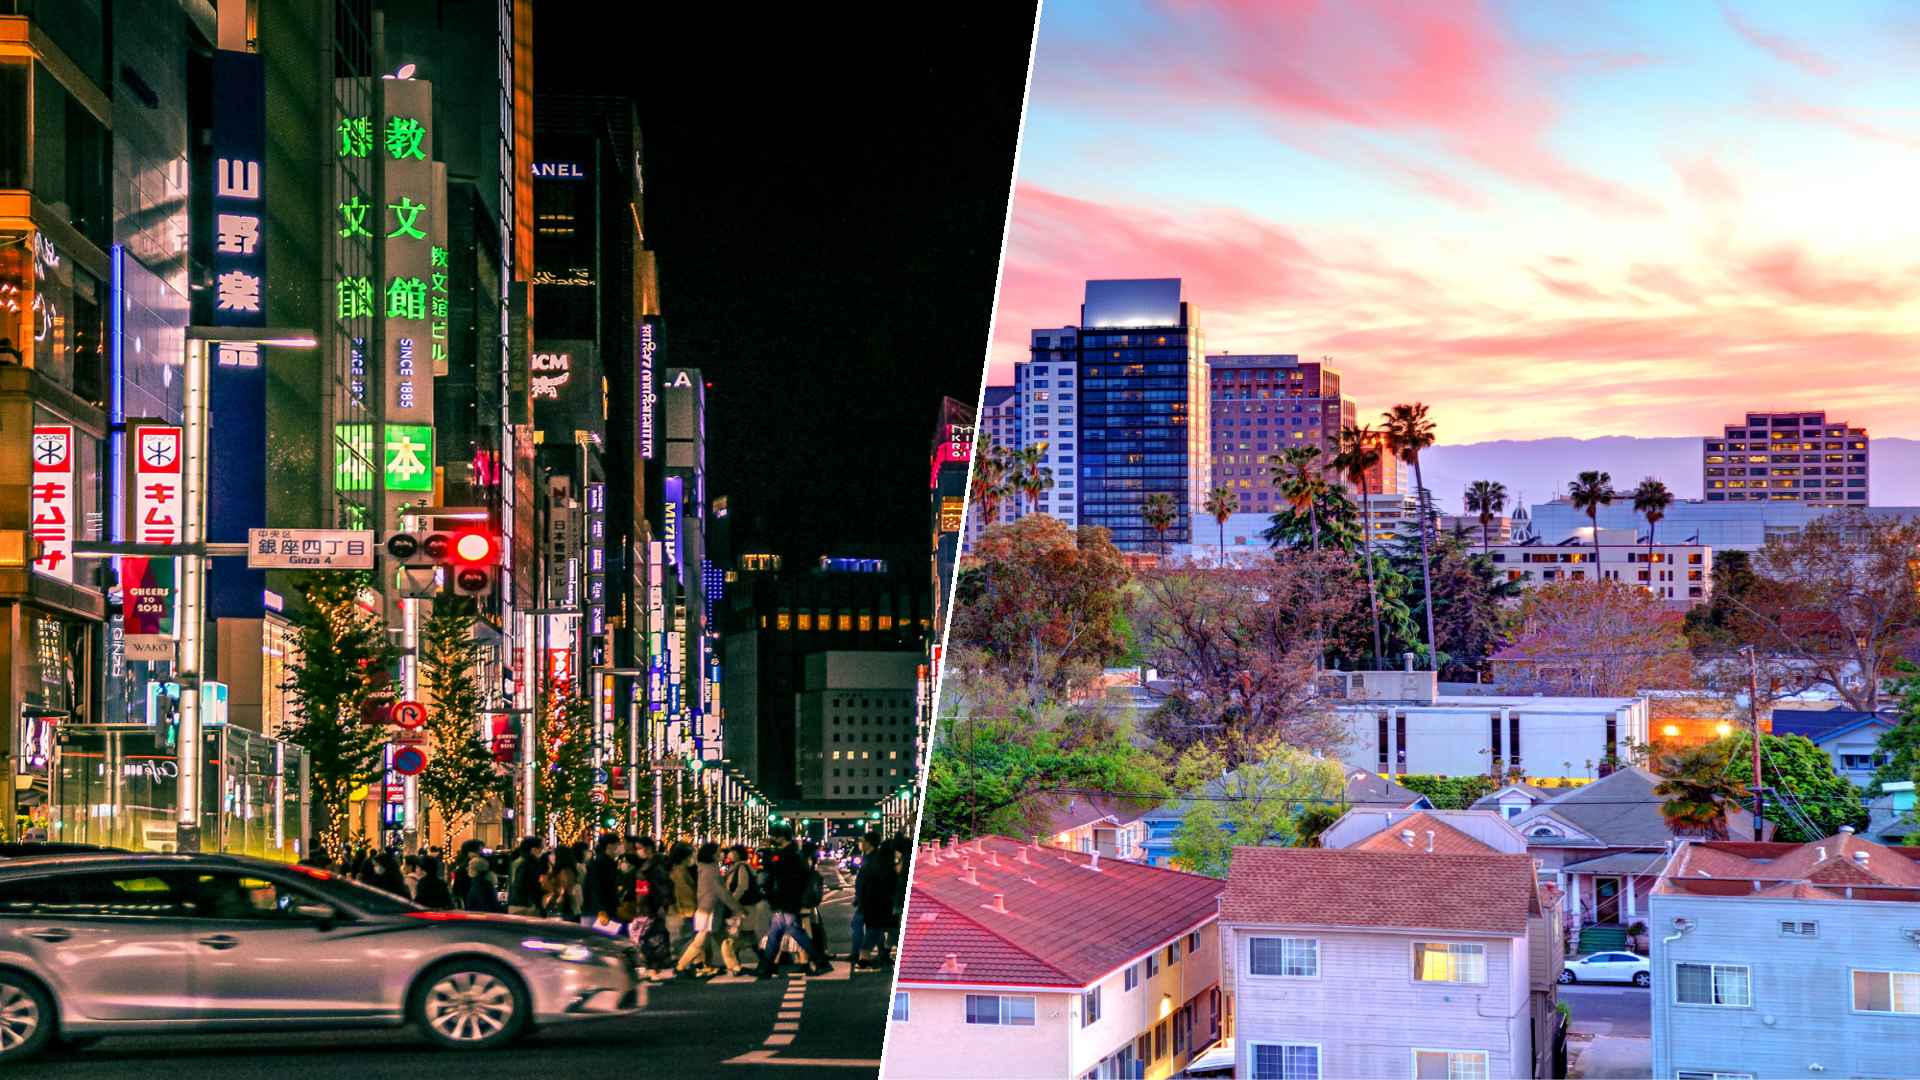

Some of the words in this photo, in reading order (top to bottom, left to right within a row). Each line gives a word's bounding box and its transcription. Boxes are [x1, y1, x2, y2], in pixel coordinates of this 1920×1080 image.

[384, 115, 427, 320] 教文館
[401, 338, 413, 376] SINCE
[401, 382, 413, 408] 1885
[386, 436, 426, 481] 本
[258, 539, 364, 555] 銀座四丁目
[289, 555, 320, 564] Ginza
[324, 556, 332, 564] 4
[130, 588, 169, 596] CHEERS
[137, 604, 163, 612] 2021
[134, 642, 168, 652] WAKO
